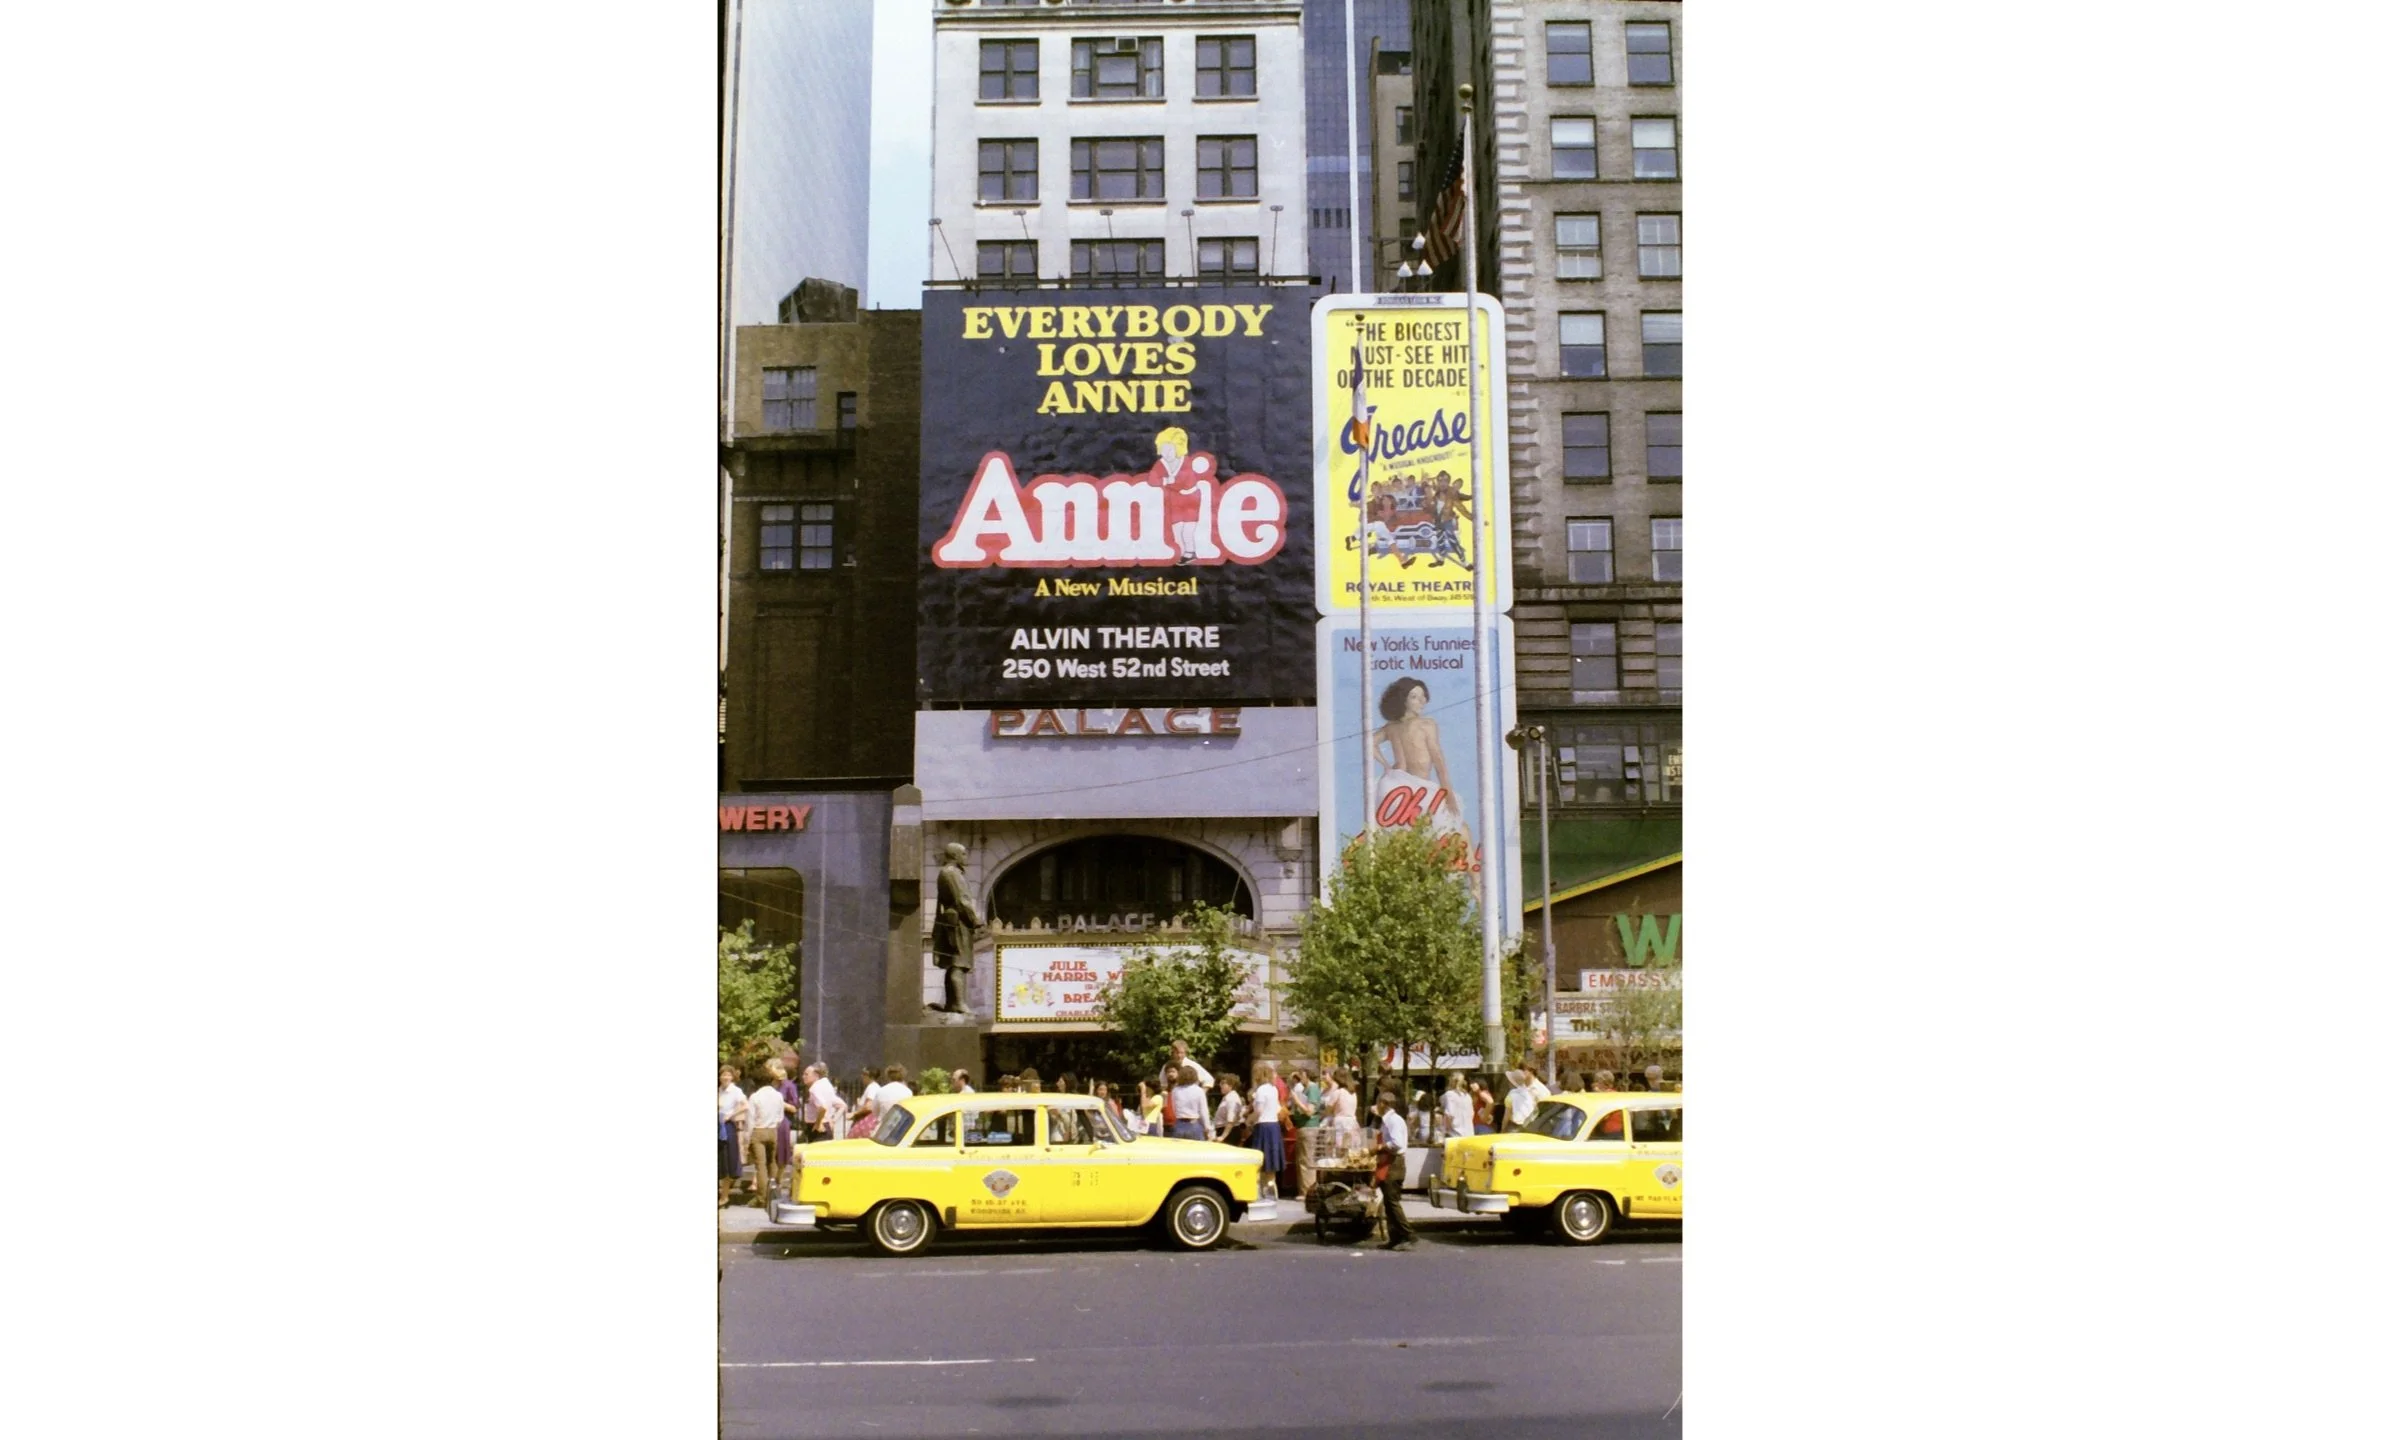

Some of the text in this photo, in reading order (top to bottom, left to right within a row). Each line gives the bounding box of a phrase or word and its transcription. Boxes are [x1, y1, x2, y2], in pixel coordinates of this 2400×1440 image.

[962, 304, 1273, 339] EVERYBODY
[1346, 321, 1461, 341] “HE BIGGEST
[1036, 342, 1196, 376] LOVES
[1442, 345, 1470, 364] HIT
[1363, 369, 1394, 388] THE
[1403, 368, 1467, 388] DECADE
[1037, 380, 1192, 414] ANNIE
[1341, 406, 1471, 501] Grease
[934, 452, 1286, 567] Annie
[1034, 576, 1199, 597] A New Musical
[1412, 581, 1472, 592] THEATR
[1010, 626, 1220, 650] ALVIN THEATRE
[1381, 636, 1419, 651] York's
[1424, 636, 1477, 650] Funnies
[1003, 658, 1230, 679] 250 West 52nd Street
[1409, 654, 1463, 669] Musical
[990, 708, 1242, 738] PALACE
[1376, 785, 1448, 828] Oh!
[719, 804, 812, 831] WERY
[1057, 912, 1155, 933] PALACE
[1615, 913, 1682, 967] W
[1049, 961, 1088, 971] JULIE
[1042, 972, 1098, 982] HARRIS
[1063, 993, 1106, 1004] BREA
[1555, 1002, 1597, 1014] BARBRA
